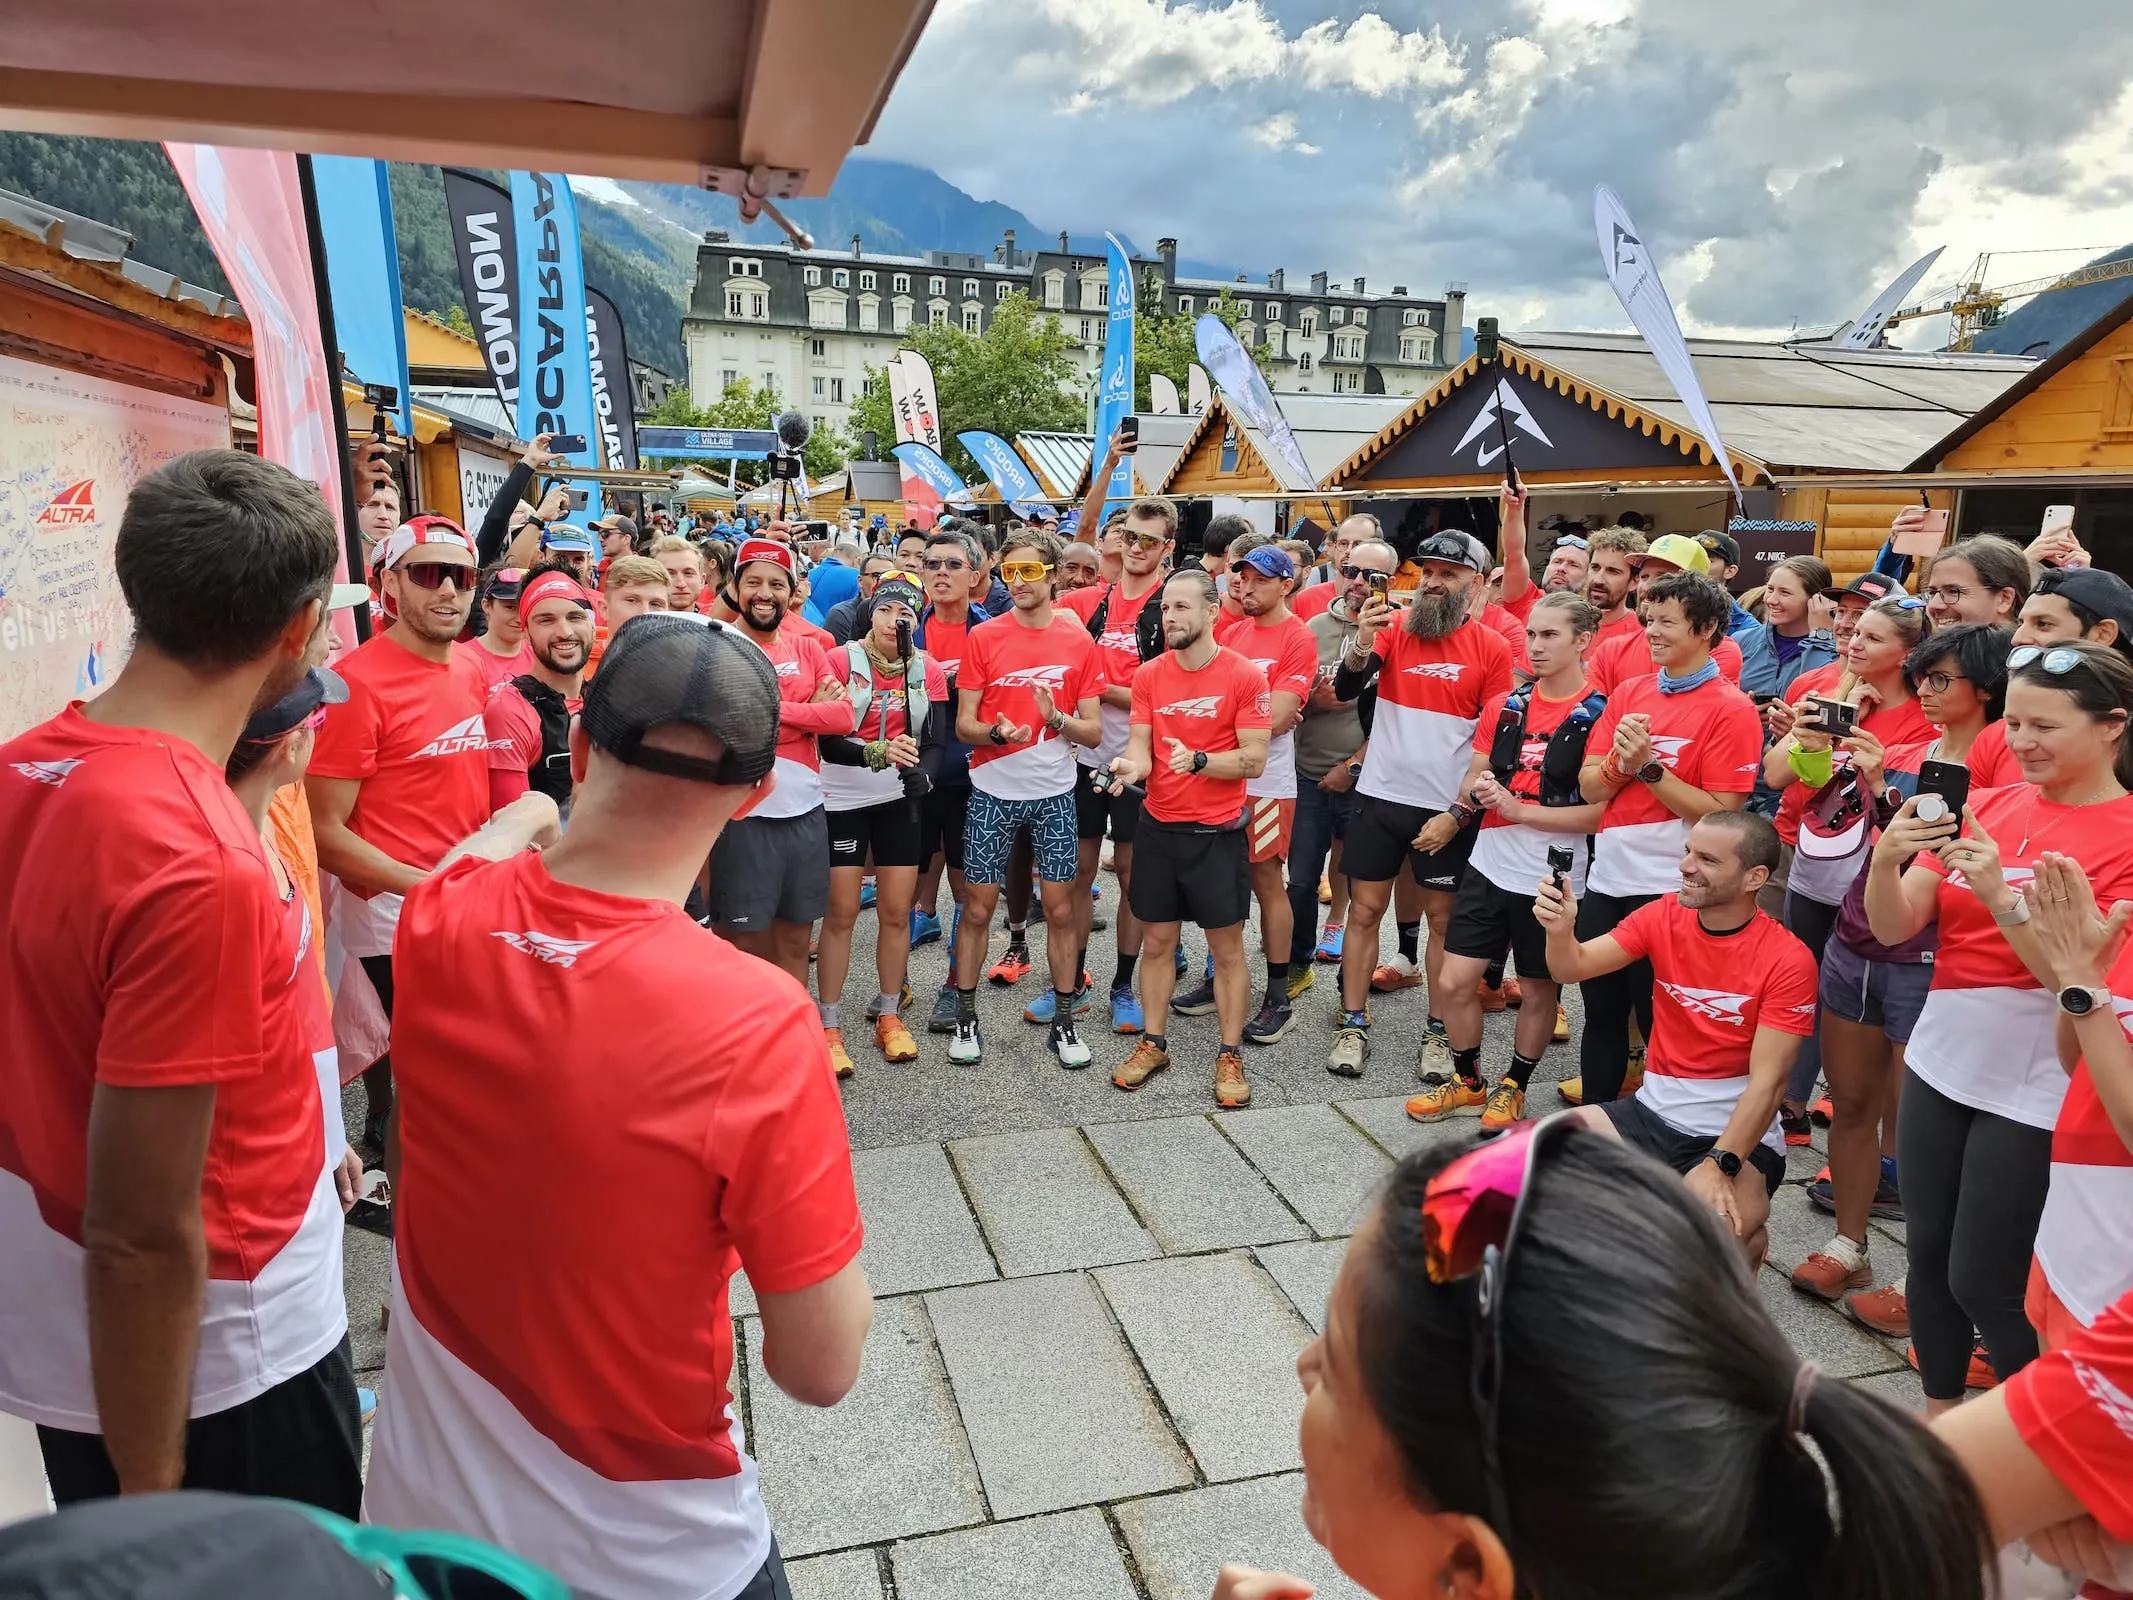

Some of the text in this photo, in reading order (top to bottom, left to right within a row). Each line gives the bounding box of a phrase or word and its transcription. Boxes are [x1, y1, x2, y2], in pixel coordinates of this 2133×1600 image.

[701, 438, 734, 446] VILLAGE
[36, 507, 95, 524] ALTRA
[1767, 551, 1786, 561] NIKE
[1, 602, 34, 649] ell
[1401, 668, 1460, 682] ALTRA
[405, 737, 487, 761] ALTRA
[9, 762, 67, 789] ALTRA
[489, 931, 577, 969] ALTRA
[1656, 978, 1745, 1027] ALTRA
